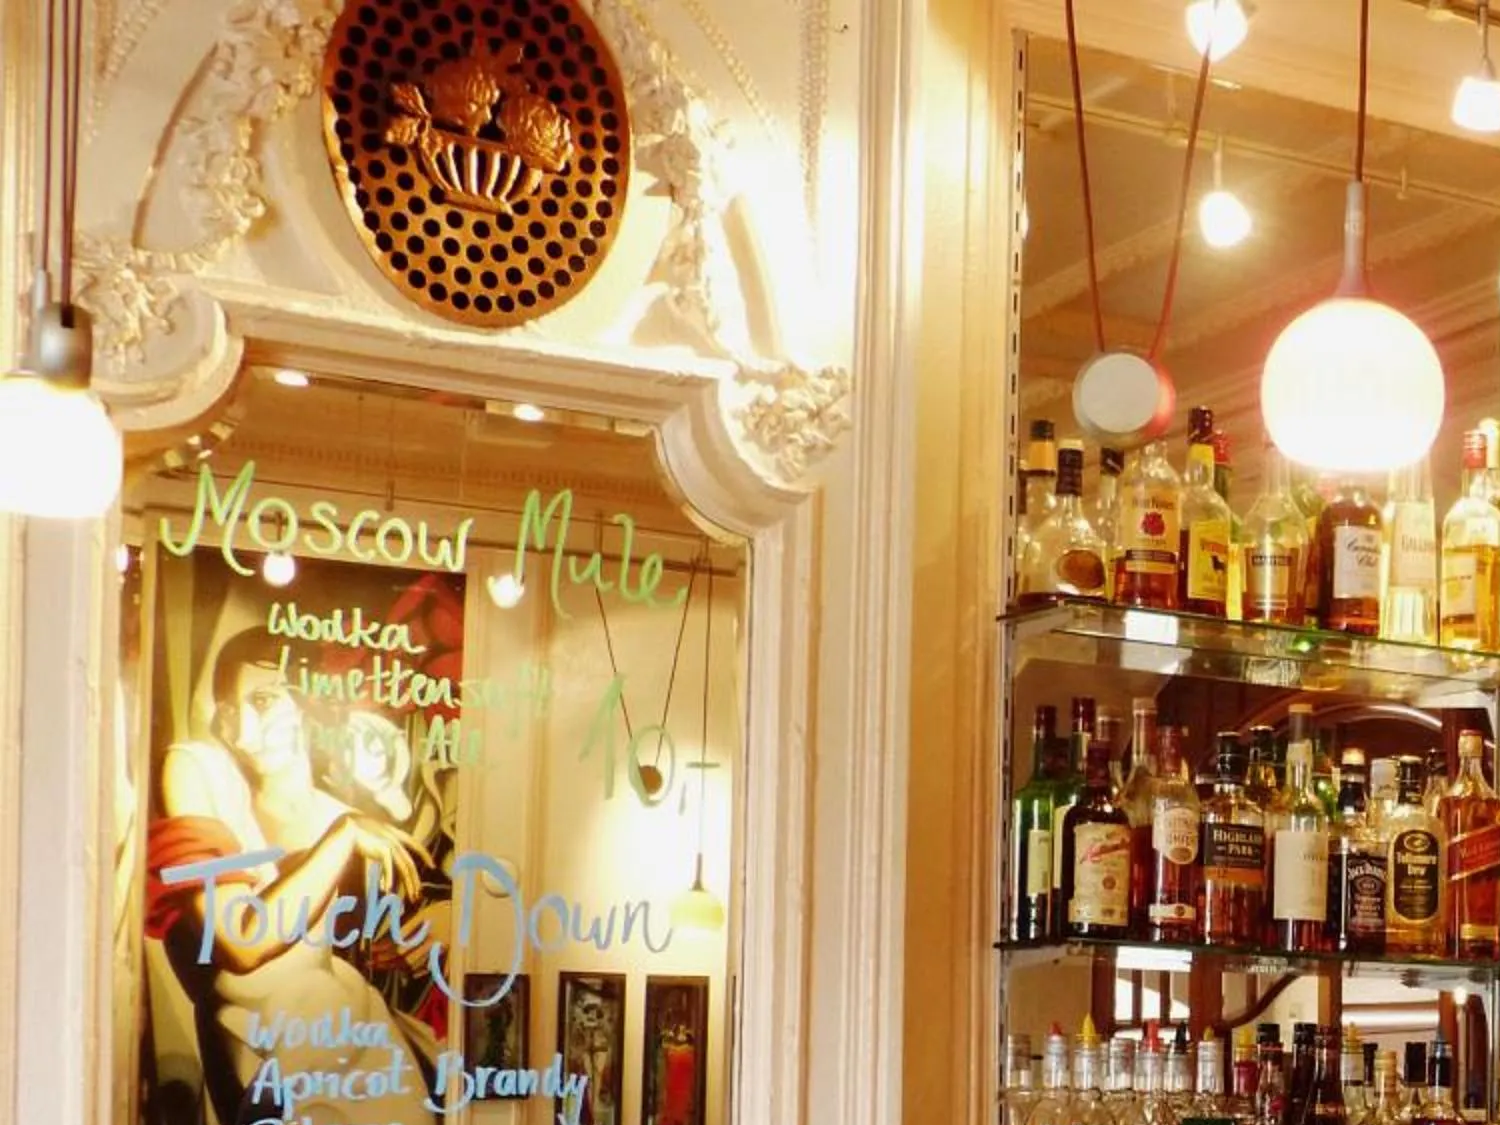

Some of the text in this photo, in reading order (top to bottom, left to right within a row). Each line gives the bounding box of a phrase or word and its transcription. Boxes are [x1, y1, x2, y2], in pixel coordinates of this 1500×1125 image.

[512, 489, 688, 620] Mule
[267, 602, 427, 653] Wodka
[160, 848, 429, 966] Touch
[250, 1053, 412, 1120] Apricot
